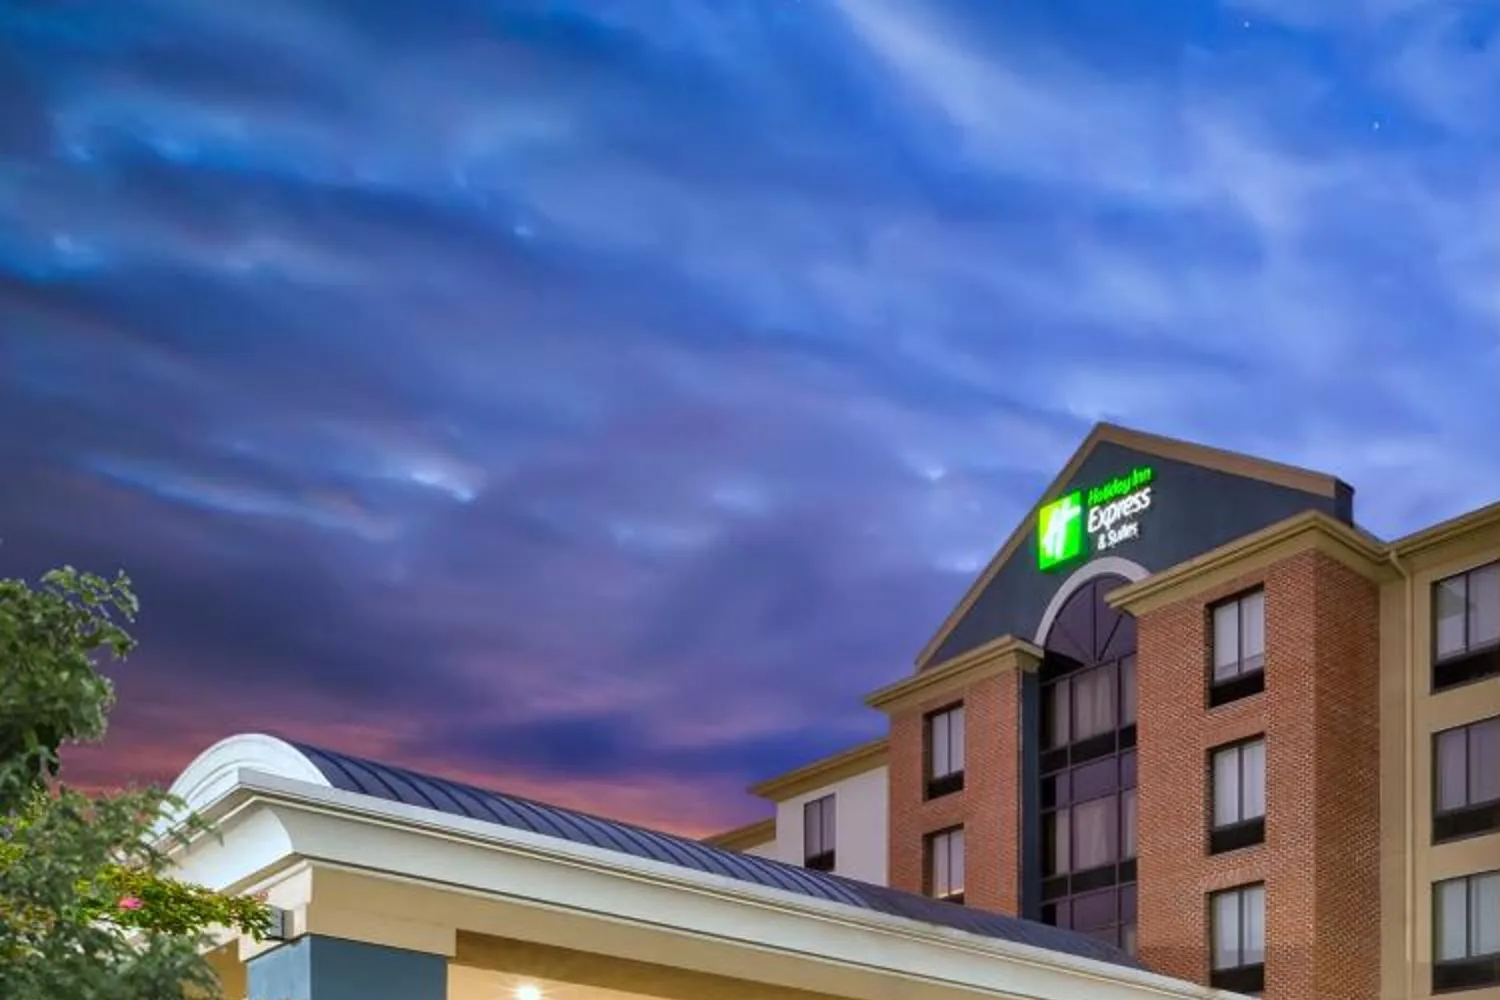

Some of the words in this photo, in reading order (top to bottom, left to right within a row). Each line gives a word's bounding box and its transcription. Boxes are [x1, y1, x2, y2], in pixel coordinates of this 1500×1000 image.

[1088, 478, 1131, 505] Holiday
[1132, 467, 1152, 486] Inn
[1087, 487, 1152, 533] Express
[1097, 532, 1107, 551] &
[1107, 522, 1139, 549] Suites
